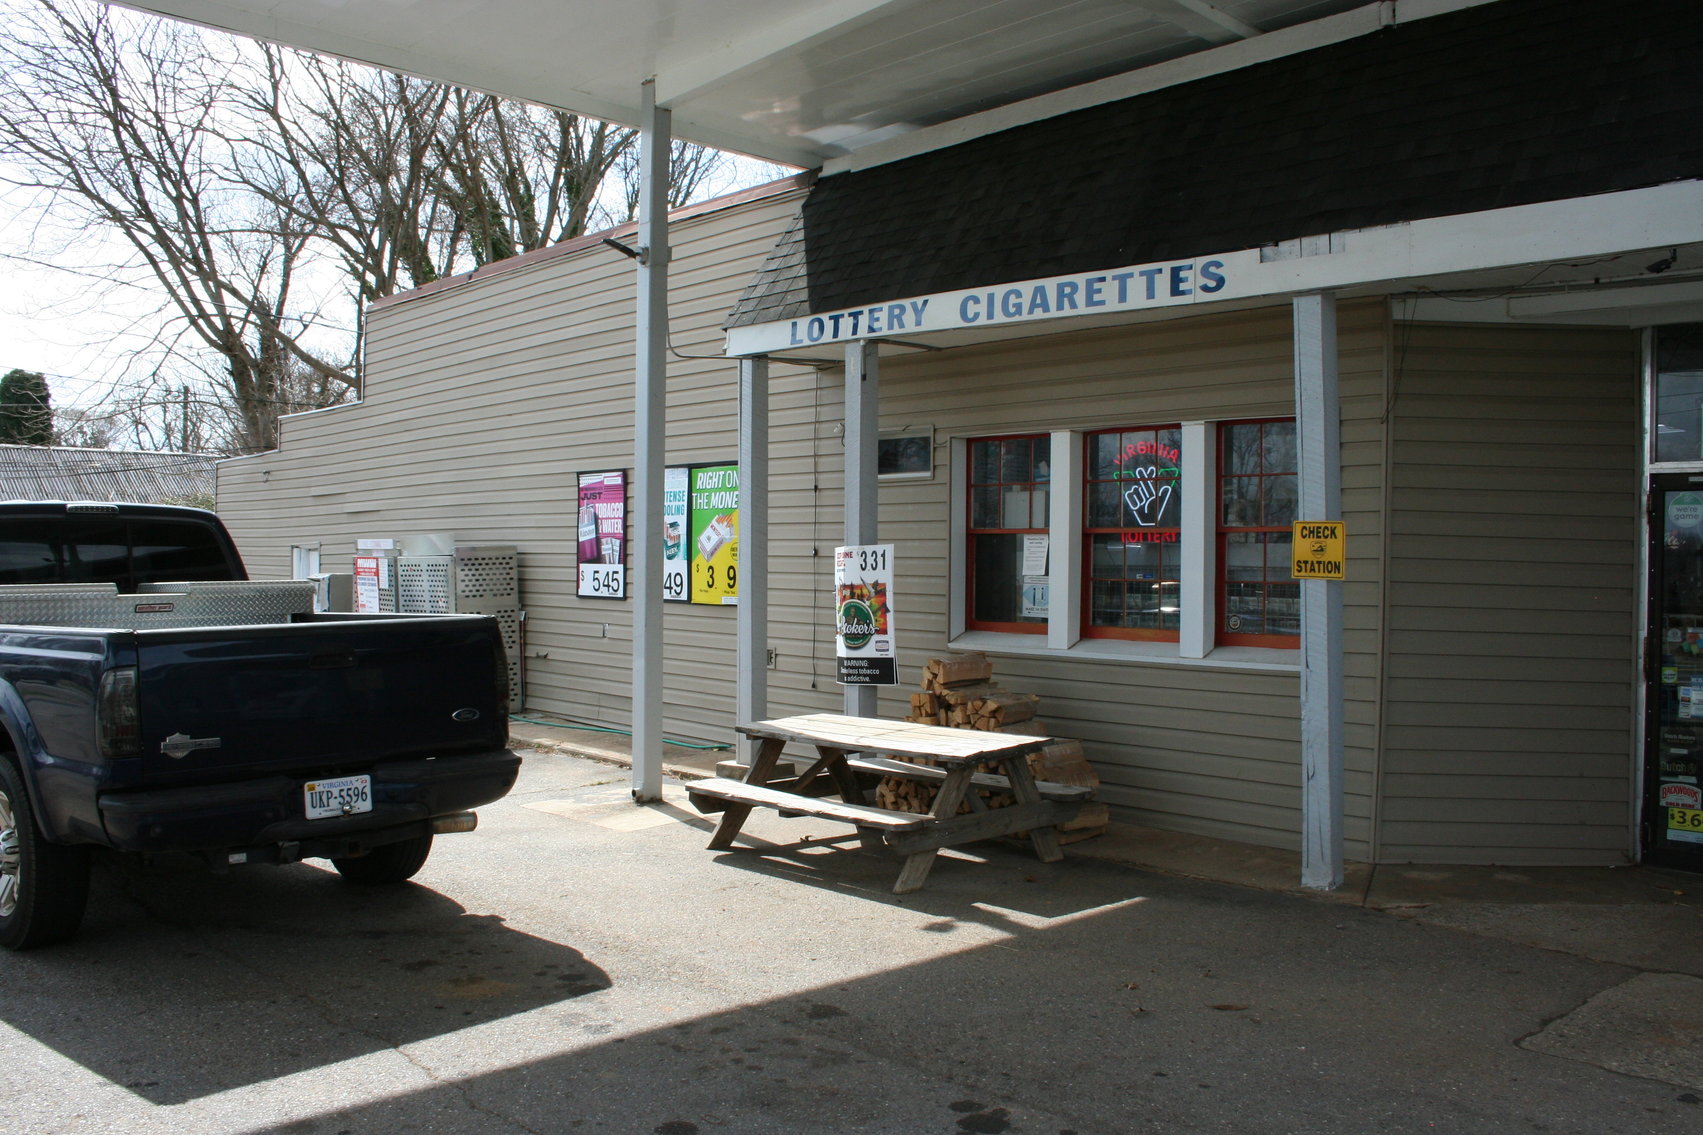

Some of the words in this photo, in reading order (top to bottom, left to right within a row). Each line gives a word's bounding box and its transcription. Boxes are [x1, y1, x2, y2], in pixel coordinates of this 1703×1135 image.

[790, 298, 929, 346] LOTTERY
[959, 259, 1227, 325] CIGARETTES
[696, 470, 725, 490] RIGHT
[580, 491, 603, 501] JUST
[692, 492, 709, 510] THE
[595, 502, 624, 519] TOBACCO
[1675, 505, 1698, 513] we're
[1673, 513, 1700, 521] game
[1300, 525, 1338, 540] CHECK
[1295, 559, 1342, 574] STATION
[322, 779, 354, 790] VIRGINIA
[310, 785, 369, 809] UKP-5596
